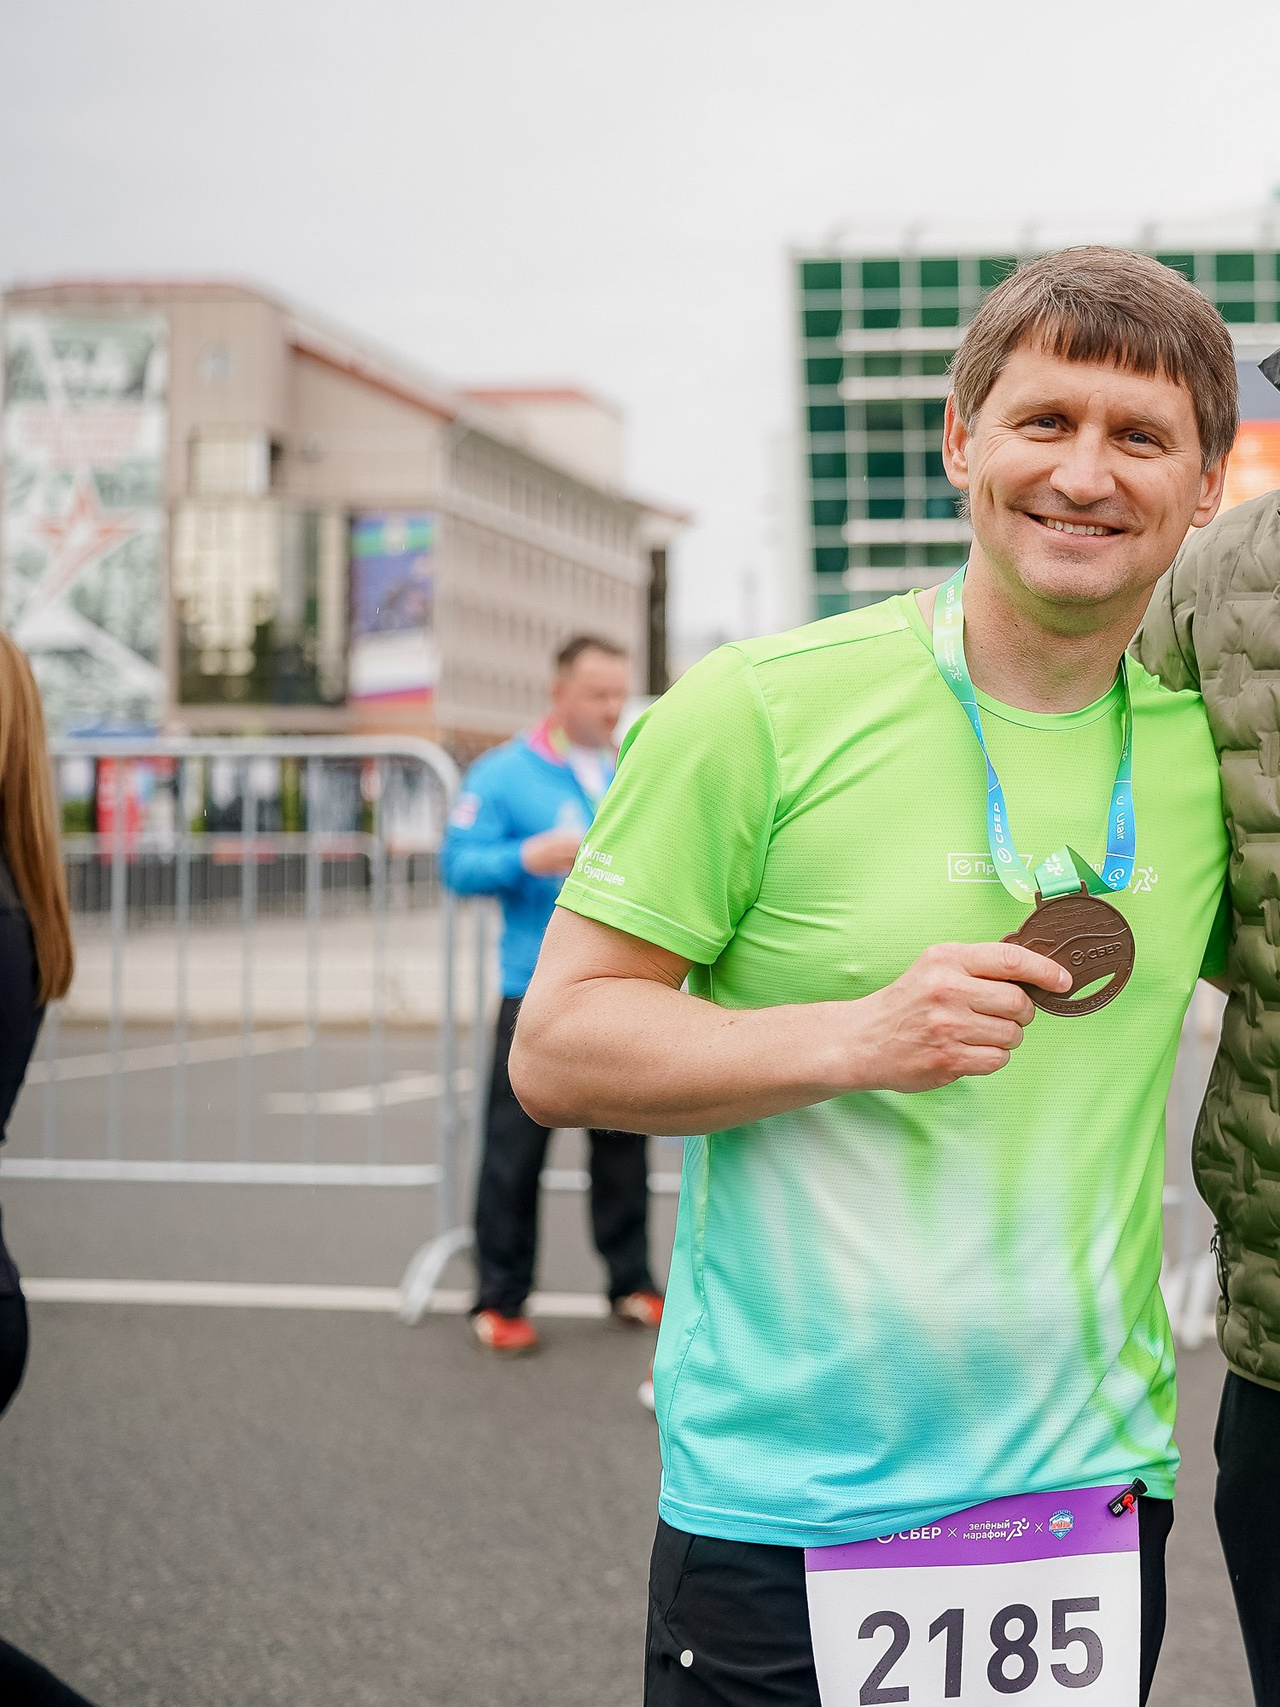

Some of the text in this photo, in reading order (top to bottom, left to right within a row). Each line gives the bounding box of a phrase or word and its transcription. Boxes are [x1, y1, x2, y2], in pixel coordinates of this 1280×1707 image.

[945, 584, 955, 605] 185
[993, 802, 1004, 844] СБЕР
[1116, 812, 1126, 840] Utair
[583, 862, 625, 886] будущее
[1086, 942, 1122, 960] СБЕР
[899, 1527, 942, 1541] СБЕР
[968, 1518, 1010, 1531] зелёный
[962, 1529, 1007, 1542] марафон
[857, 1597, 1104, 1706] 2185
